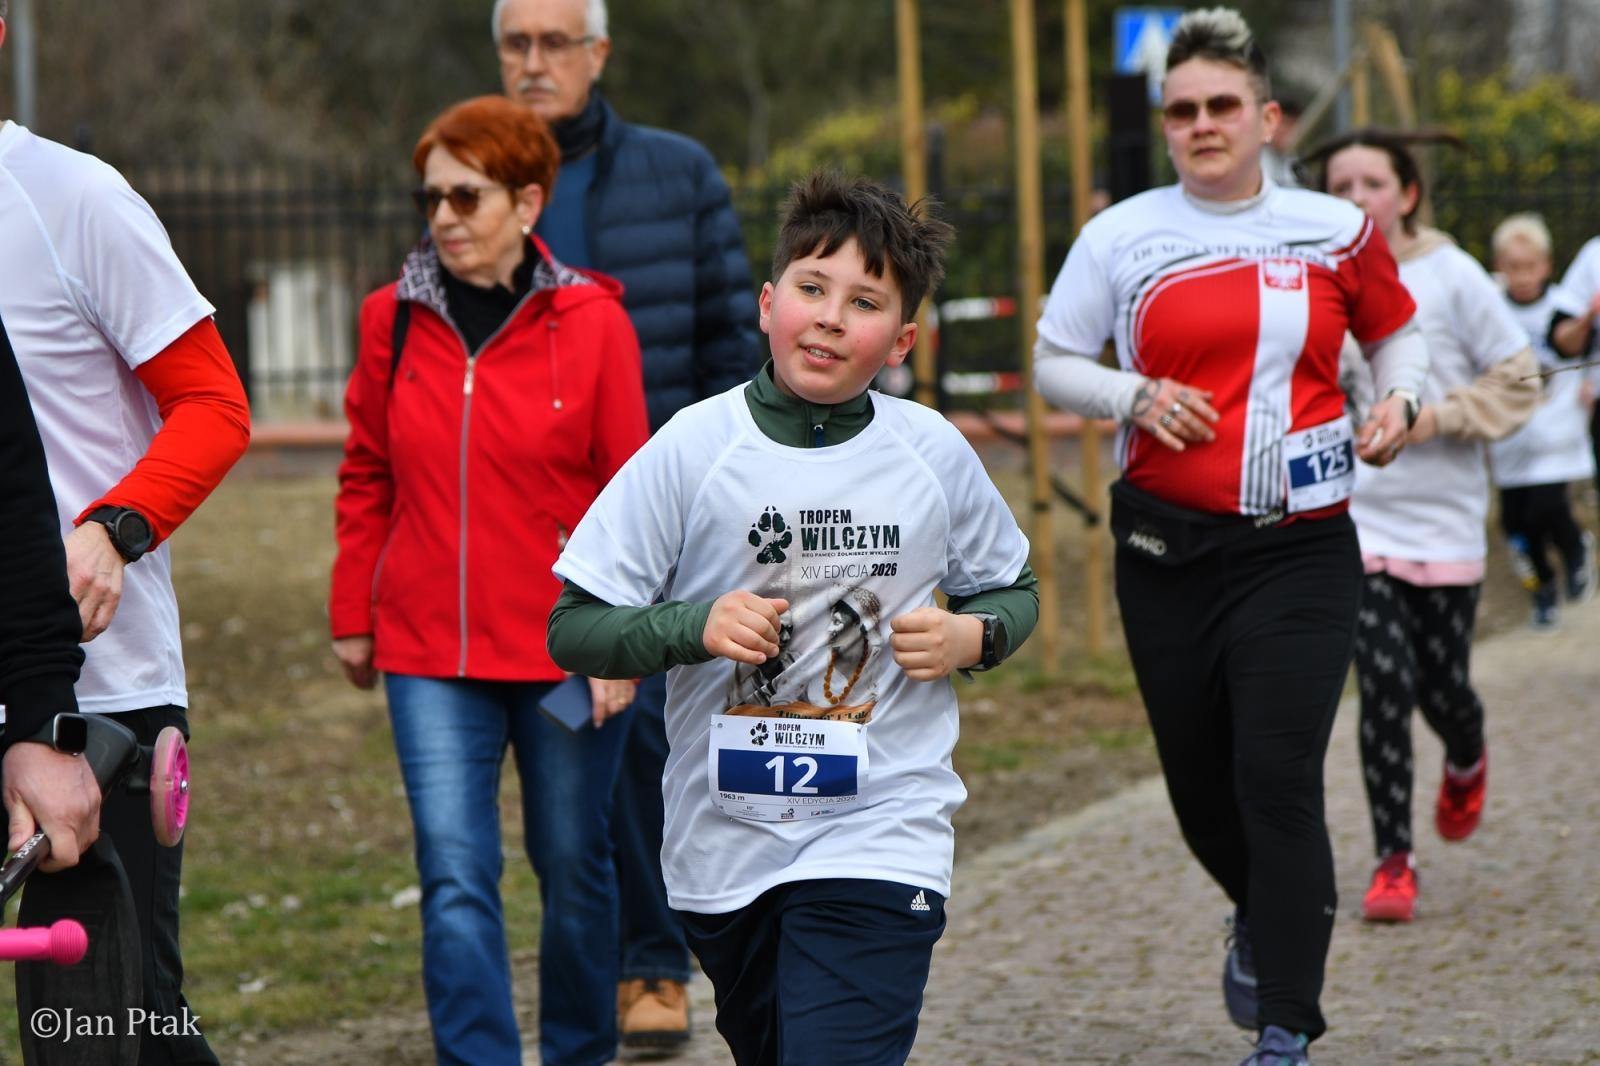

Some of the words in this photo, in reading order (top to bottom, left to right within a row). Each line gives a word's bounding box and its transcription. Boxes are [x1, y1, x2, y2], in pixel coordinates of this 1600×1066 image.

[1307, 444, 1349, 483] 125
[799, 509, 851, 525] TROPEM
[801, 525, 900, 551] WILCZYM
[801, 565, 821, 580] XIV
[824, 564, 869, 579] EDYCJA
[870, 562, 898, 577] 2026
[774, 723, 801, 732] TROPEM
[774, 732, 825, 746] WILCZYM
[765, 755, 819, 794] 12
[719, 792, 736, 801] 1963
[786, 797, 800, 805] XIV
[802, 797, 834, 805] EDYCJA
